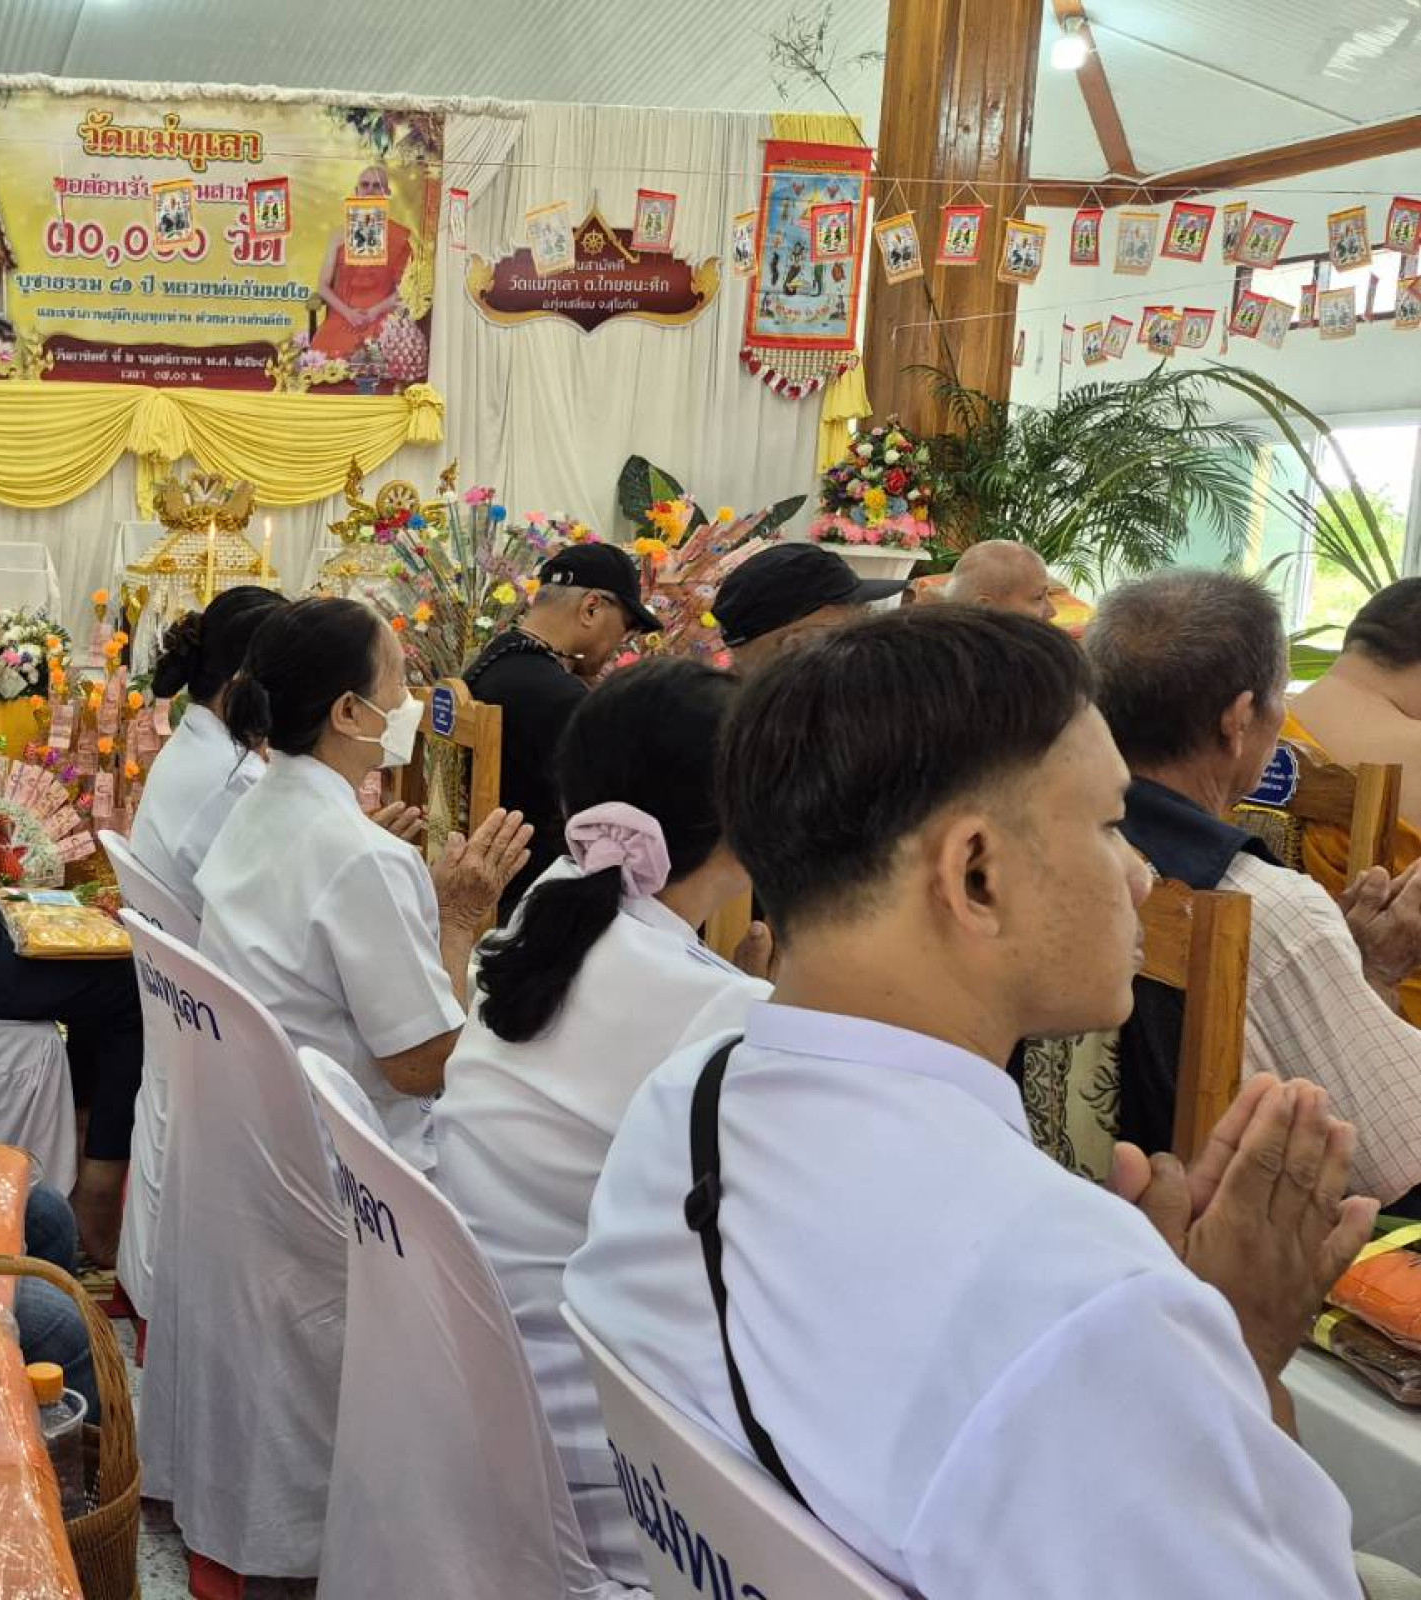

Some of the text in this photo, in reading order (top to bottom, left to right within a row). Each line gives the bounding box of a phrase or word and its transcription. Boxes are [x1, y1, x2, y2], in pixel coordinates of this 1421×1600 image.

[80, 110, 263, 172] วัดแม่ทุเลา
[47, 221, 207, 264] ๓๐,๐๐
